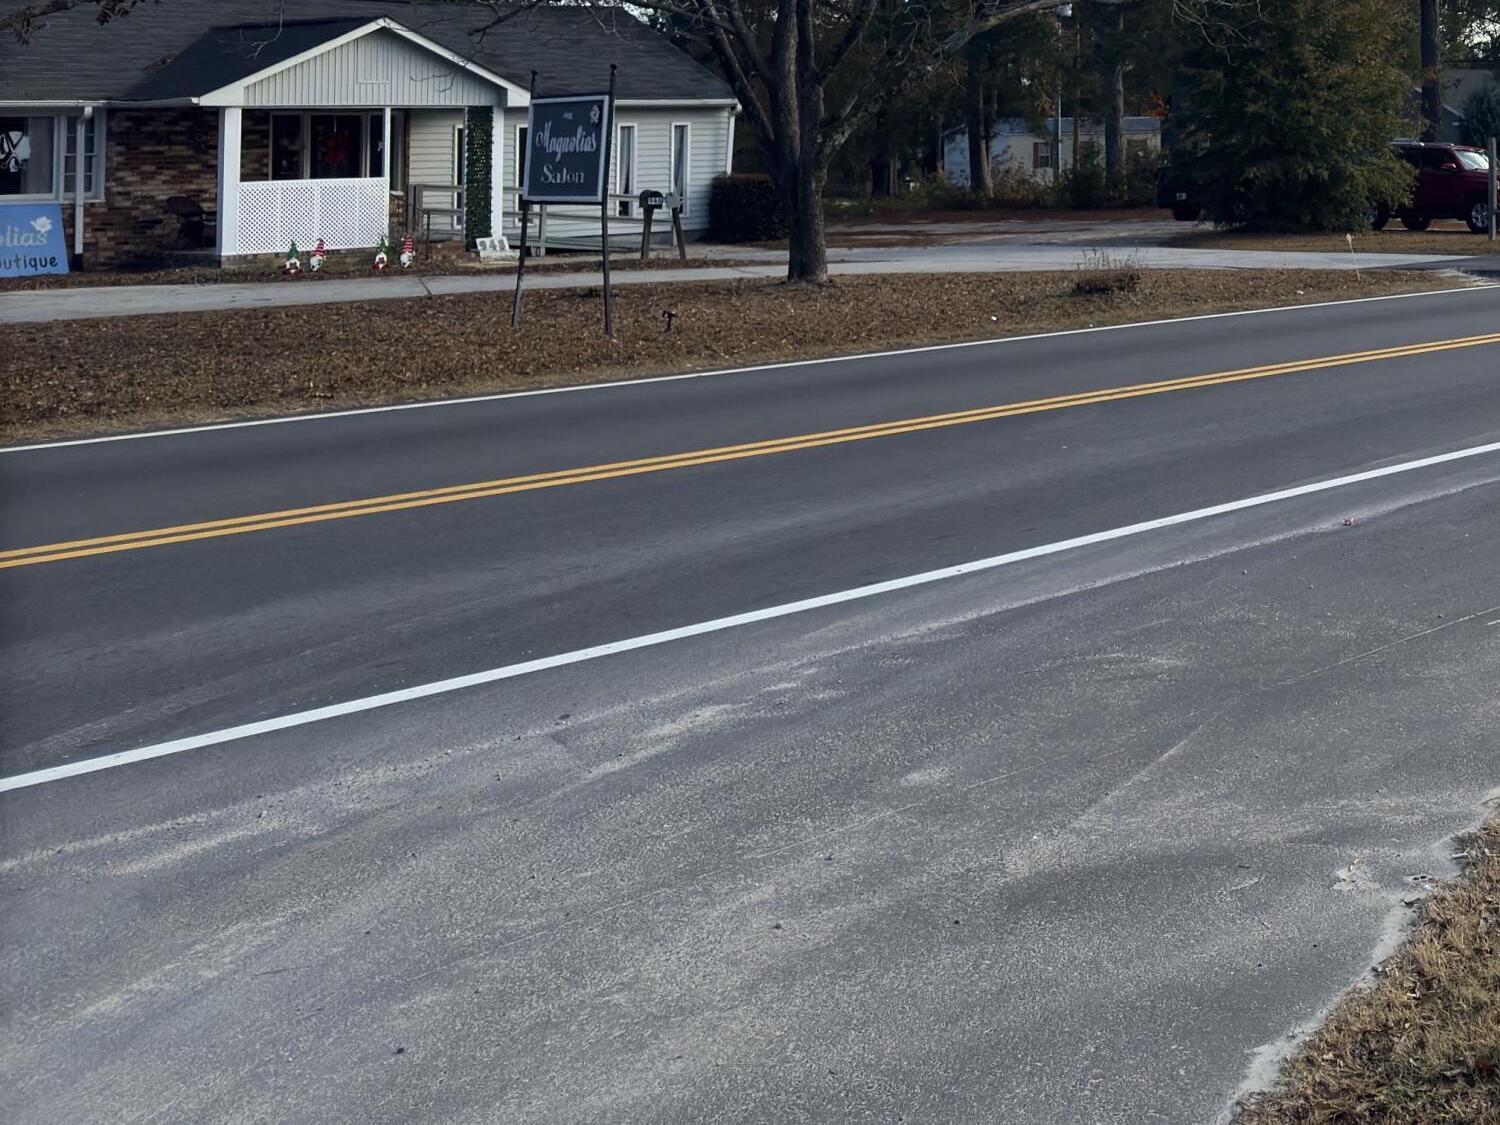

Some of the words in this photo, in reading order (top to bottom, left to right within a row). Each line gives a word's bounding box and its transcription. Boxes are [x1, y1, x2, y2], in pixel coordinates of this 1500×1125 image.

[535, 121, 597, 163] Magnolias
[540, 163, 585, 184] Salon
[0, 254, 58, 271] utique
